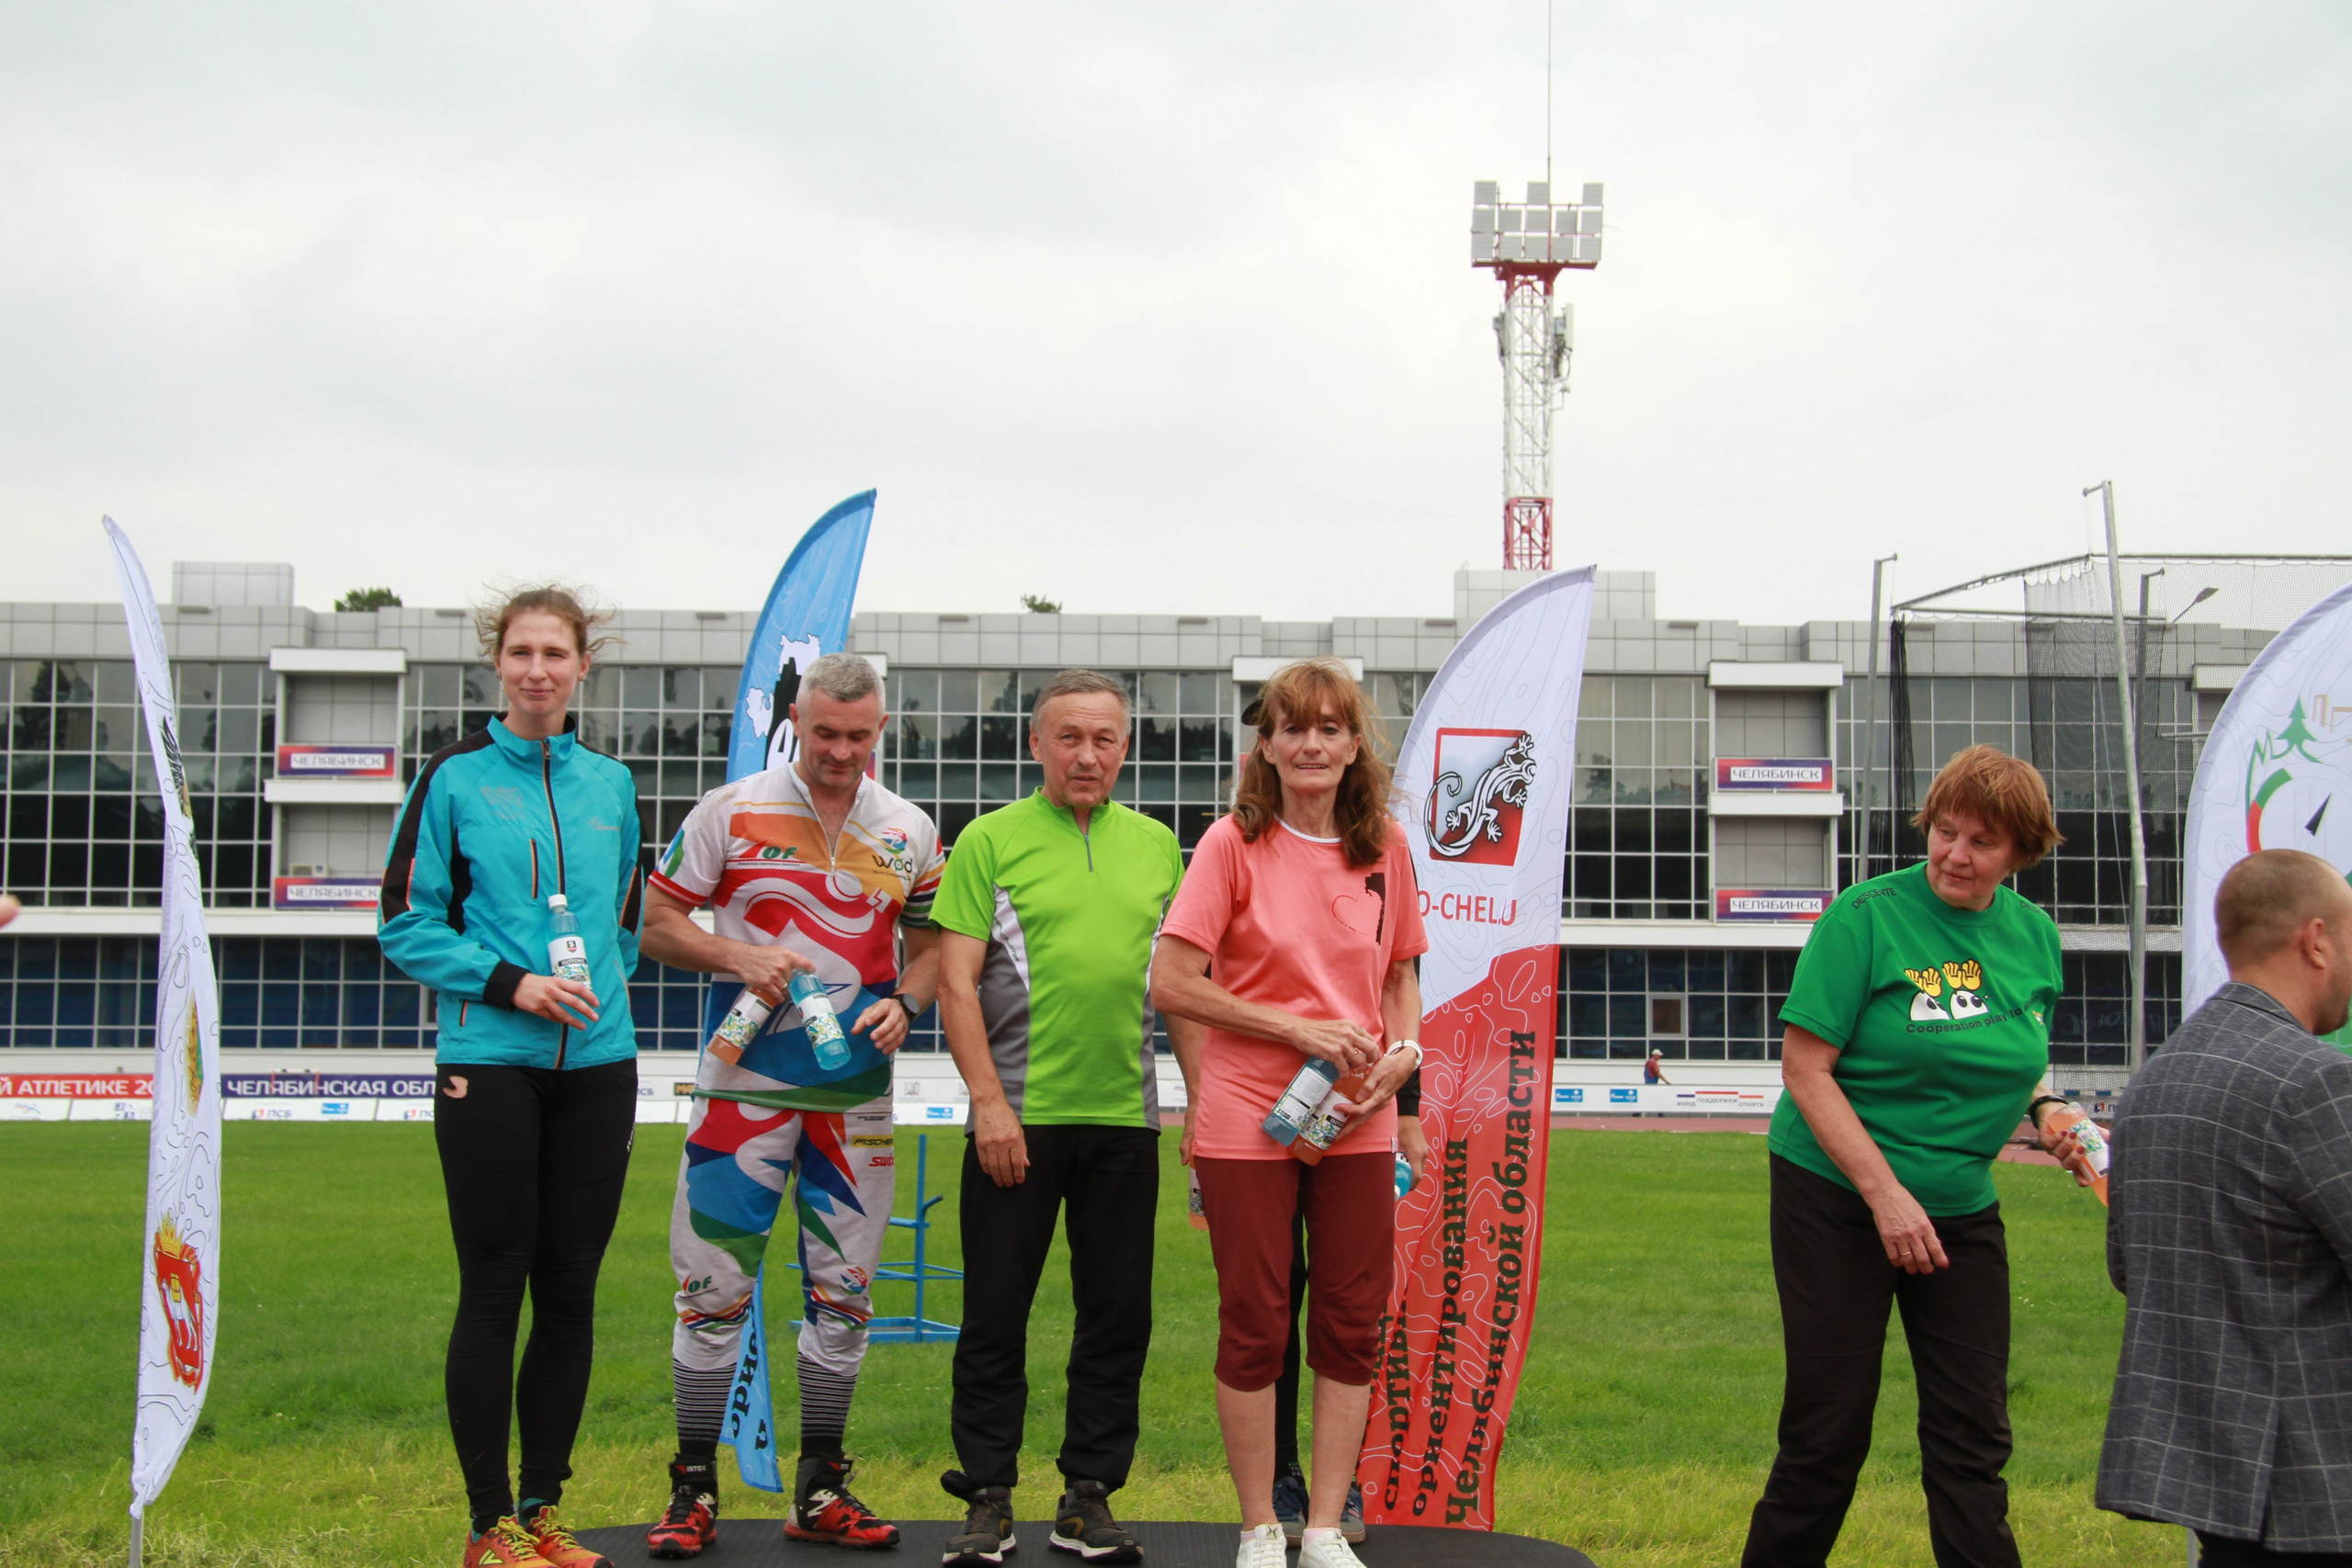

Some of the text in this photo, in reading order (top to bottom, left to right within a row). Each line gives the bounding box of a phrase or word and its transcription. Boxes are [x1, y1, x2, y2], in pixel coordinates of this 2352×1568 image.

[292, 754, 381, 766] ЧЕЛЯБИНСК
[1732, 769, 1819, 780] ЧЕЛЯБИНСК
[288, 886, 379, 898] ЧЕЛЯБИНСК
[1732, 900, 1819, 910] ЧЕЛЯБИНСК
[1906, 1008, 2022, 1034] Cooperation play to
[17, 1079, 130, 1095] АТЛЕТИКЕ
[227, 1079, 387, 1096] ЧЕЛЯБИНСКАЯ
[1445, 1030, 1536, 1525] Челябинской области
[1412, 1137, 1468, 1517] ориентирования
